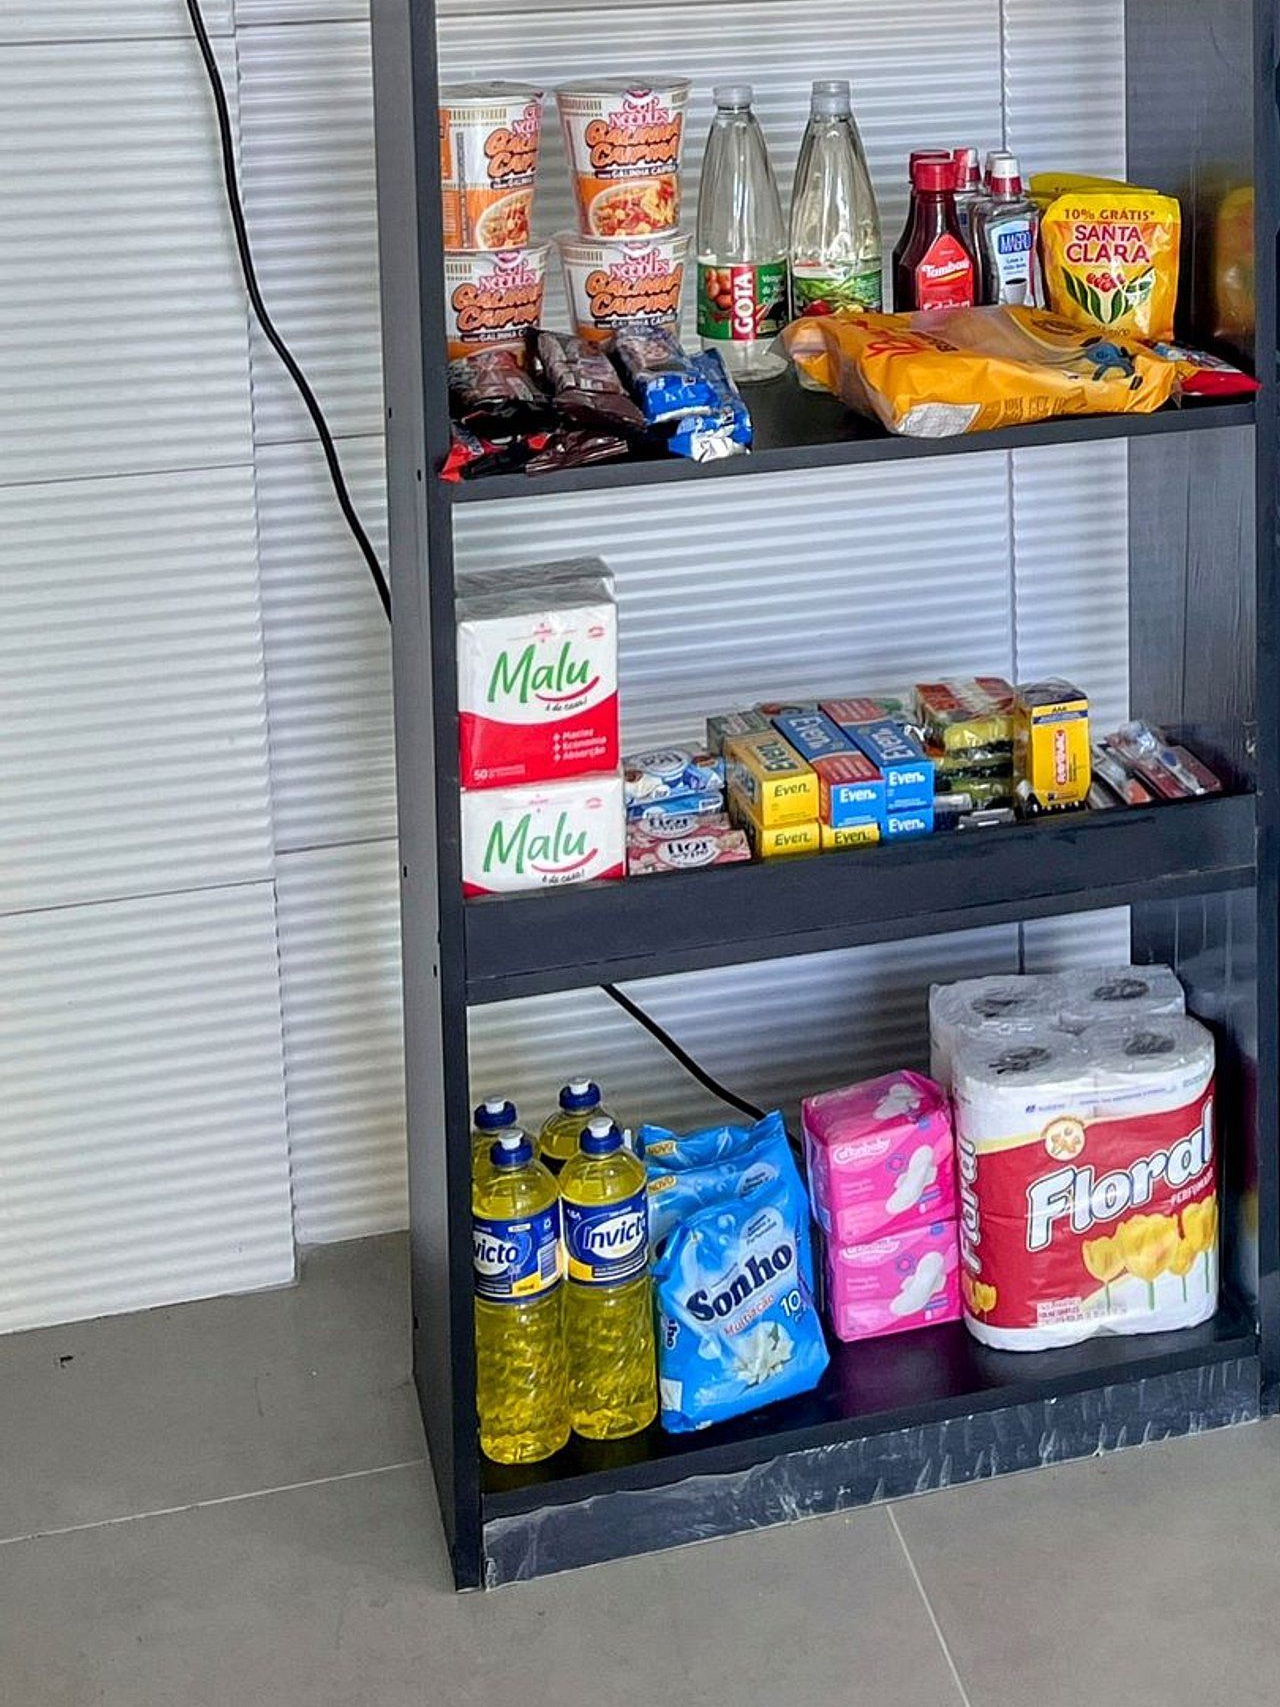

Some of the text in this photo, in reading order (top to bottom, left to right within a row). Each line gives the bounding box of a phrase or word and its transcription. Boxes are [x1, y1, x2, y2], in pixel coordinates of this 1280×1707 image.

[1063, 208, 1096, 221] 10%
[1074, 224, 1142, 243] SANTA
[1065, 243, 1151, 264] CLARA
[733, 271, 755, 335] GOTA
[487, 641, 591, 705] Malu
[473, 768, 489, 782] 50
[482, 810, 590, 875] Malu
[1027, 1095, 1214, 1252] Floral
[473, 1238, 520, 1265] victo
[685, 1243, 793, 1323] Sonho
[780, 1288, 801, 1317] 10
